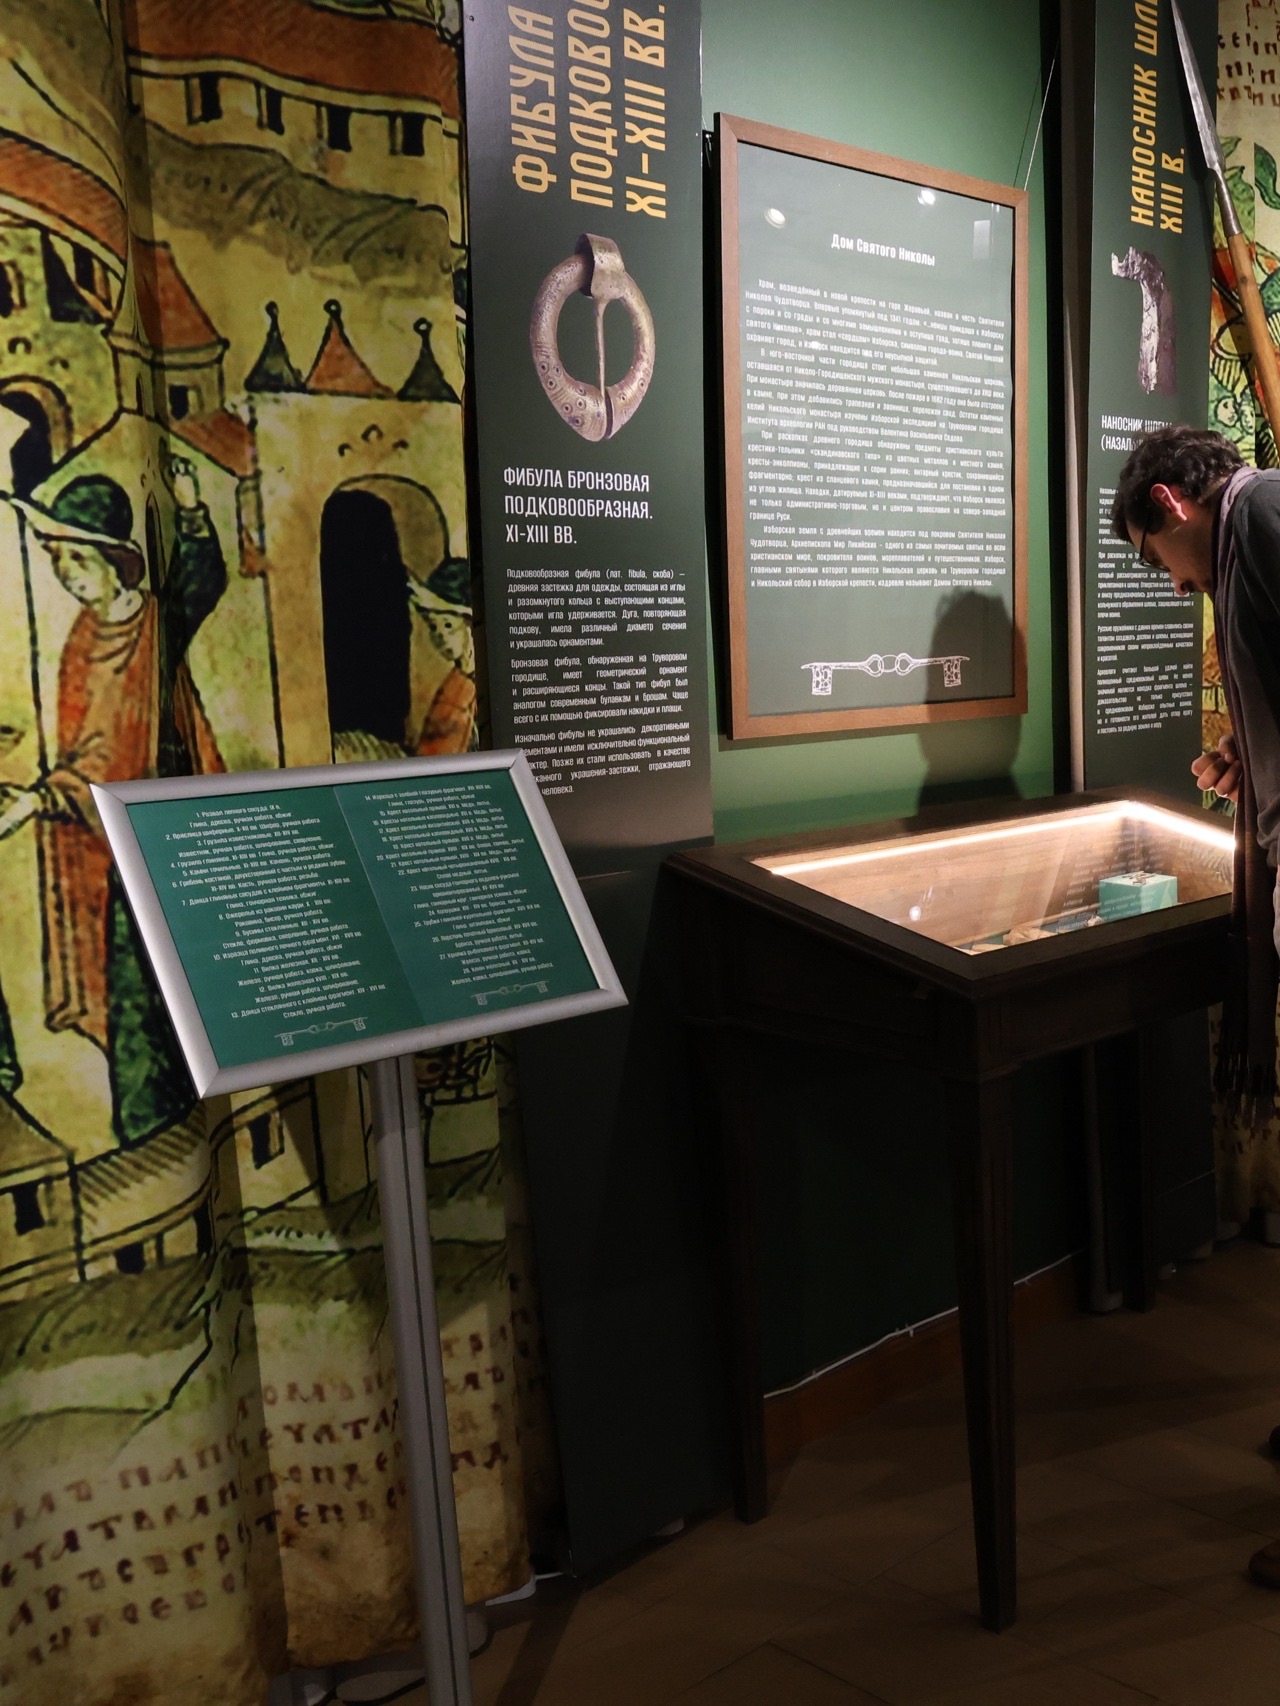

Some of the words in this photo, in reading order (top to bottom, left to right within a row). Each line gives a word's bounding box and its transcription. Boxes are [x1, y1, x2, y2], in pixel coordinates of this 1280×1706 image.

[1134, 0, 1158, 56] ШЛ
[508, 5, 557, 194] ФИБУЛА
[1131, 63, 1157, 227] НАНОСНИК
[831, 233, 853, 249] Дом
[856, 238, 896, 258] Святого
[898, 247, 935, 265] Николы
[1101, 415, 1143, 432] НАНОСНИК
[504, 467, 563, 488] ФИБУЛА
[567, 470, 650, 492] БРОНЗОВАЯ
[505, 495, 653, 519] ПОДКОВООБРАЗНАЯ.
[506, 568, 569, 578] Подковообразная
[574, 568, 600, 579] фибула
[605, 568, 622, 579] (лат.
[652, 569, 674, 578] скоба)
[507, 583, 538, 592] древняя
[575, 583, 589, 592] для
[591, 583, 621, 592] одежды,
[624, 583, 658, 591] состоящая
[660, 583, 668, 591] из
[669, 583, 685, 591] иглы
[517, 597, 564, 606] разомкнутого
[568, 597, 592, 605] кольца
[604, 597, 654, 605] выступающими
[657, 596, 685, 604] концами,
[508, 612, 543, 620] которыми
[547, 611, 563, 619] игла
[567, 610, 617, 619] удерживается.
[621, 609, 637, 619] Дуга,
[643, 609, 686, 617] повторяющая
[509, 625, 540, 634] подкову,
[550, 624, 572, 632] имела
[581, 622, 617, 633] различный
[626, 623, 653, 631] диаметр
[661, 622, 686, 630] сечения
[516, 639, 557, 649] украшалась
[558, 638, 604, 646] орнаментами.
[511, 658, 548, 668] Бронзовая
[554, 656, 581, 666] фибула,
[587, 655, 633, 664] обнаруженная
[638, 654, 646, 662] на
[652, 653, 687, 662] Труворовом
[511, 672, 548, 682] городище,
[562, 670, 582, 678] имеет
[596, 666, 646, 677] геометрический
[659, 665, 687, 674] орнамент
[584, 683, 607, 691] концы.
[613, 680, 630, 689] Такой
[635, 680, 646, 688] тип
[650, 678, 670, 688] фибул
[675, 677, 688, 686] был
[513, 700, 546, 709] аналогом
[550, 697, 596, 707] современным
[600, 695, 631, 704] булавкам
[642, 692, 668, 701] брошам.
[672, 691, 688, 699] Чаще
[513, 715, 533, 723] всего
[534, 714, 539, 722] с
[549, 711, 582, 720] помощью
[583, 708, 627, 719] фиксировали
[628, 706, 655, 715] накидки
[661, 704, 683, 712] плащи.
[514, 732, 555, 742] Изначально
[557, 729, 585, 740] фибулы
[597, 726, 635, 737] украшались
[641, 722, 689, 733] декоративными
[525, 746, 557, 757] ементами
[558, 745, 562, 753] и
[563, 743, 584, 752] имели
[587, 739, 636, 750] исключительно
[637, 733, 690, 746] функциональный
[551, 758, 573, 767] Позже
[586, 755, 605, 763] стали
[608, 750, 651, 761] использовать
[656, 749, 661, 757] в
[663, 747, 690, 756] качестве
[570, 765, 640, 779] украшения-застежки,
[648, 759, 690, 770] отражающего
[541, 785, 574, 796] человека.
